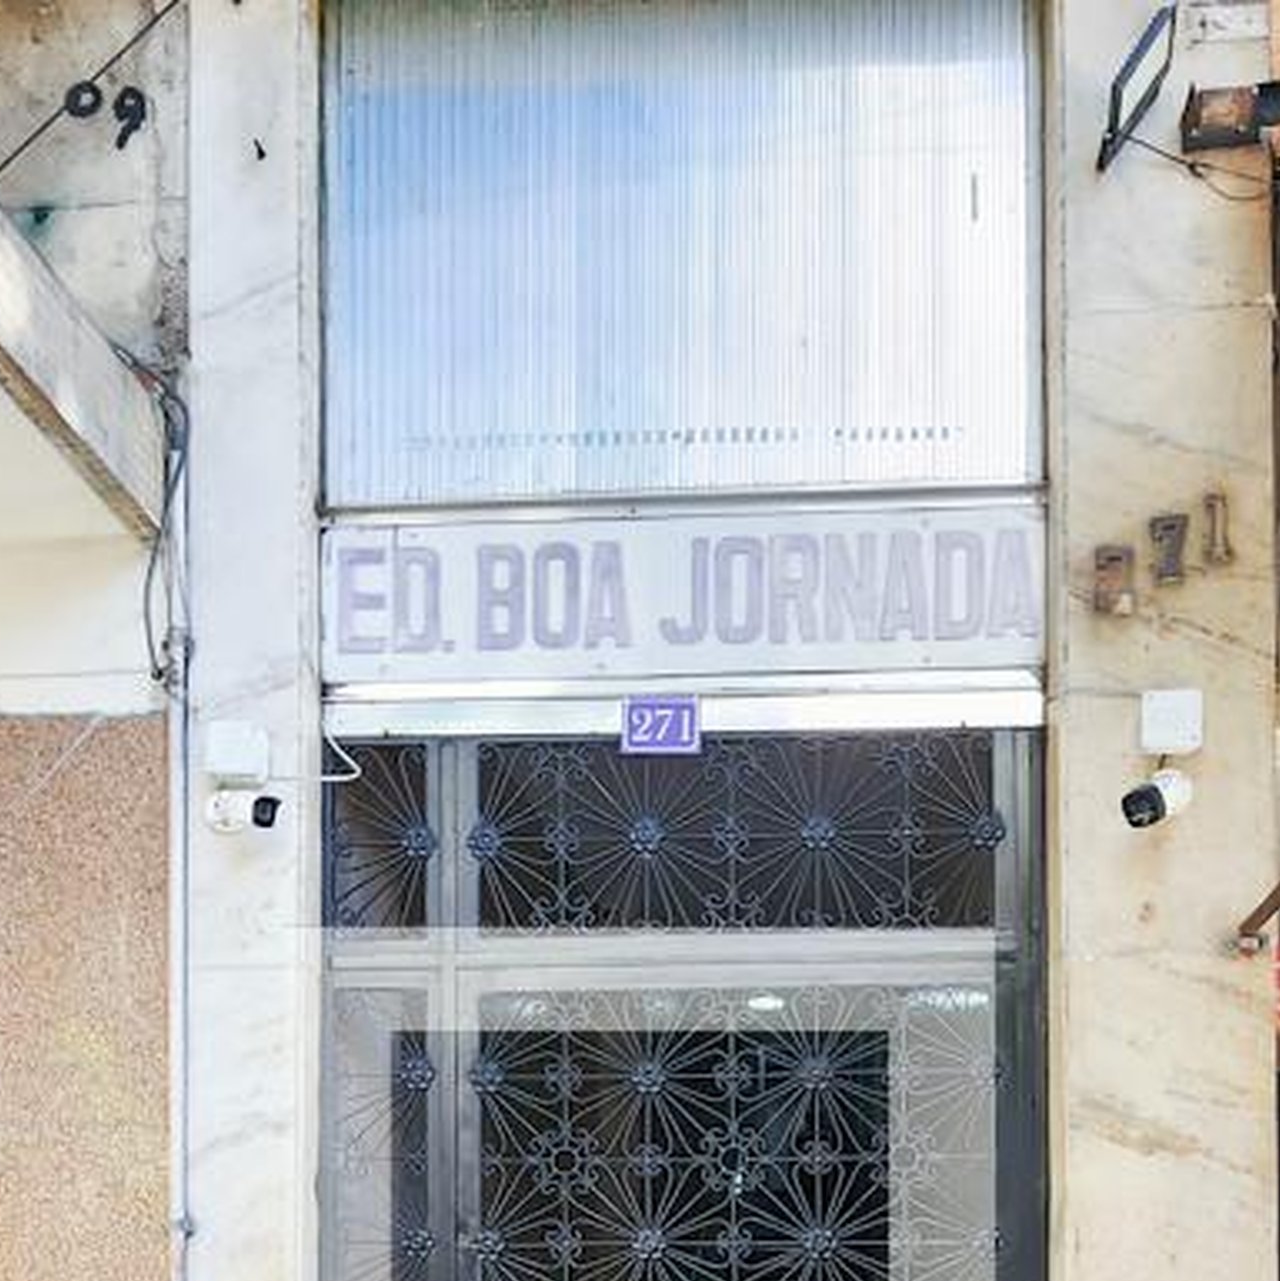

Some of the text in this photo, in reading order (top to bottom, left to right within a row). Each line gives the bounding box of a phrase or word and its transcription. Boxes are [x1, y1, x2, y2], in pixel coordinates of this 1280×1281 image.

[337, 529, 1040, 654] ED. BOA JORNADA
[631, 709, 690, 742] 271
